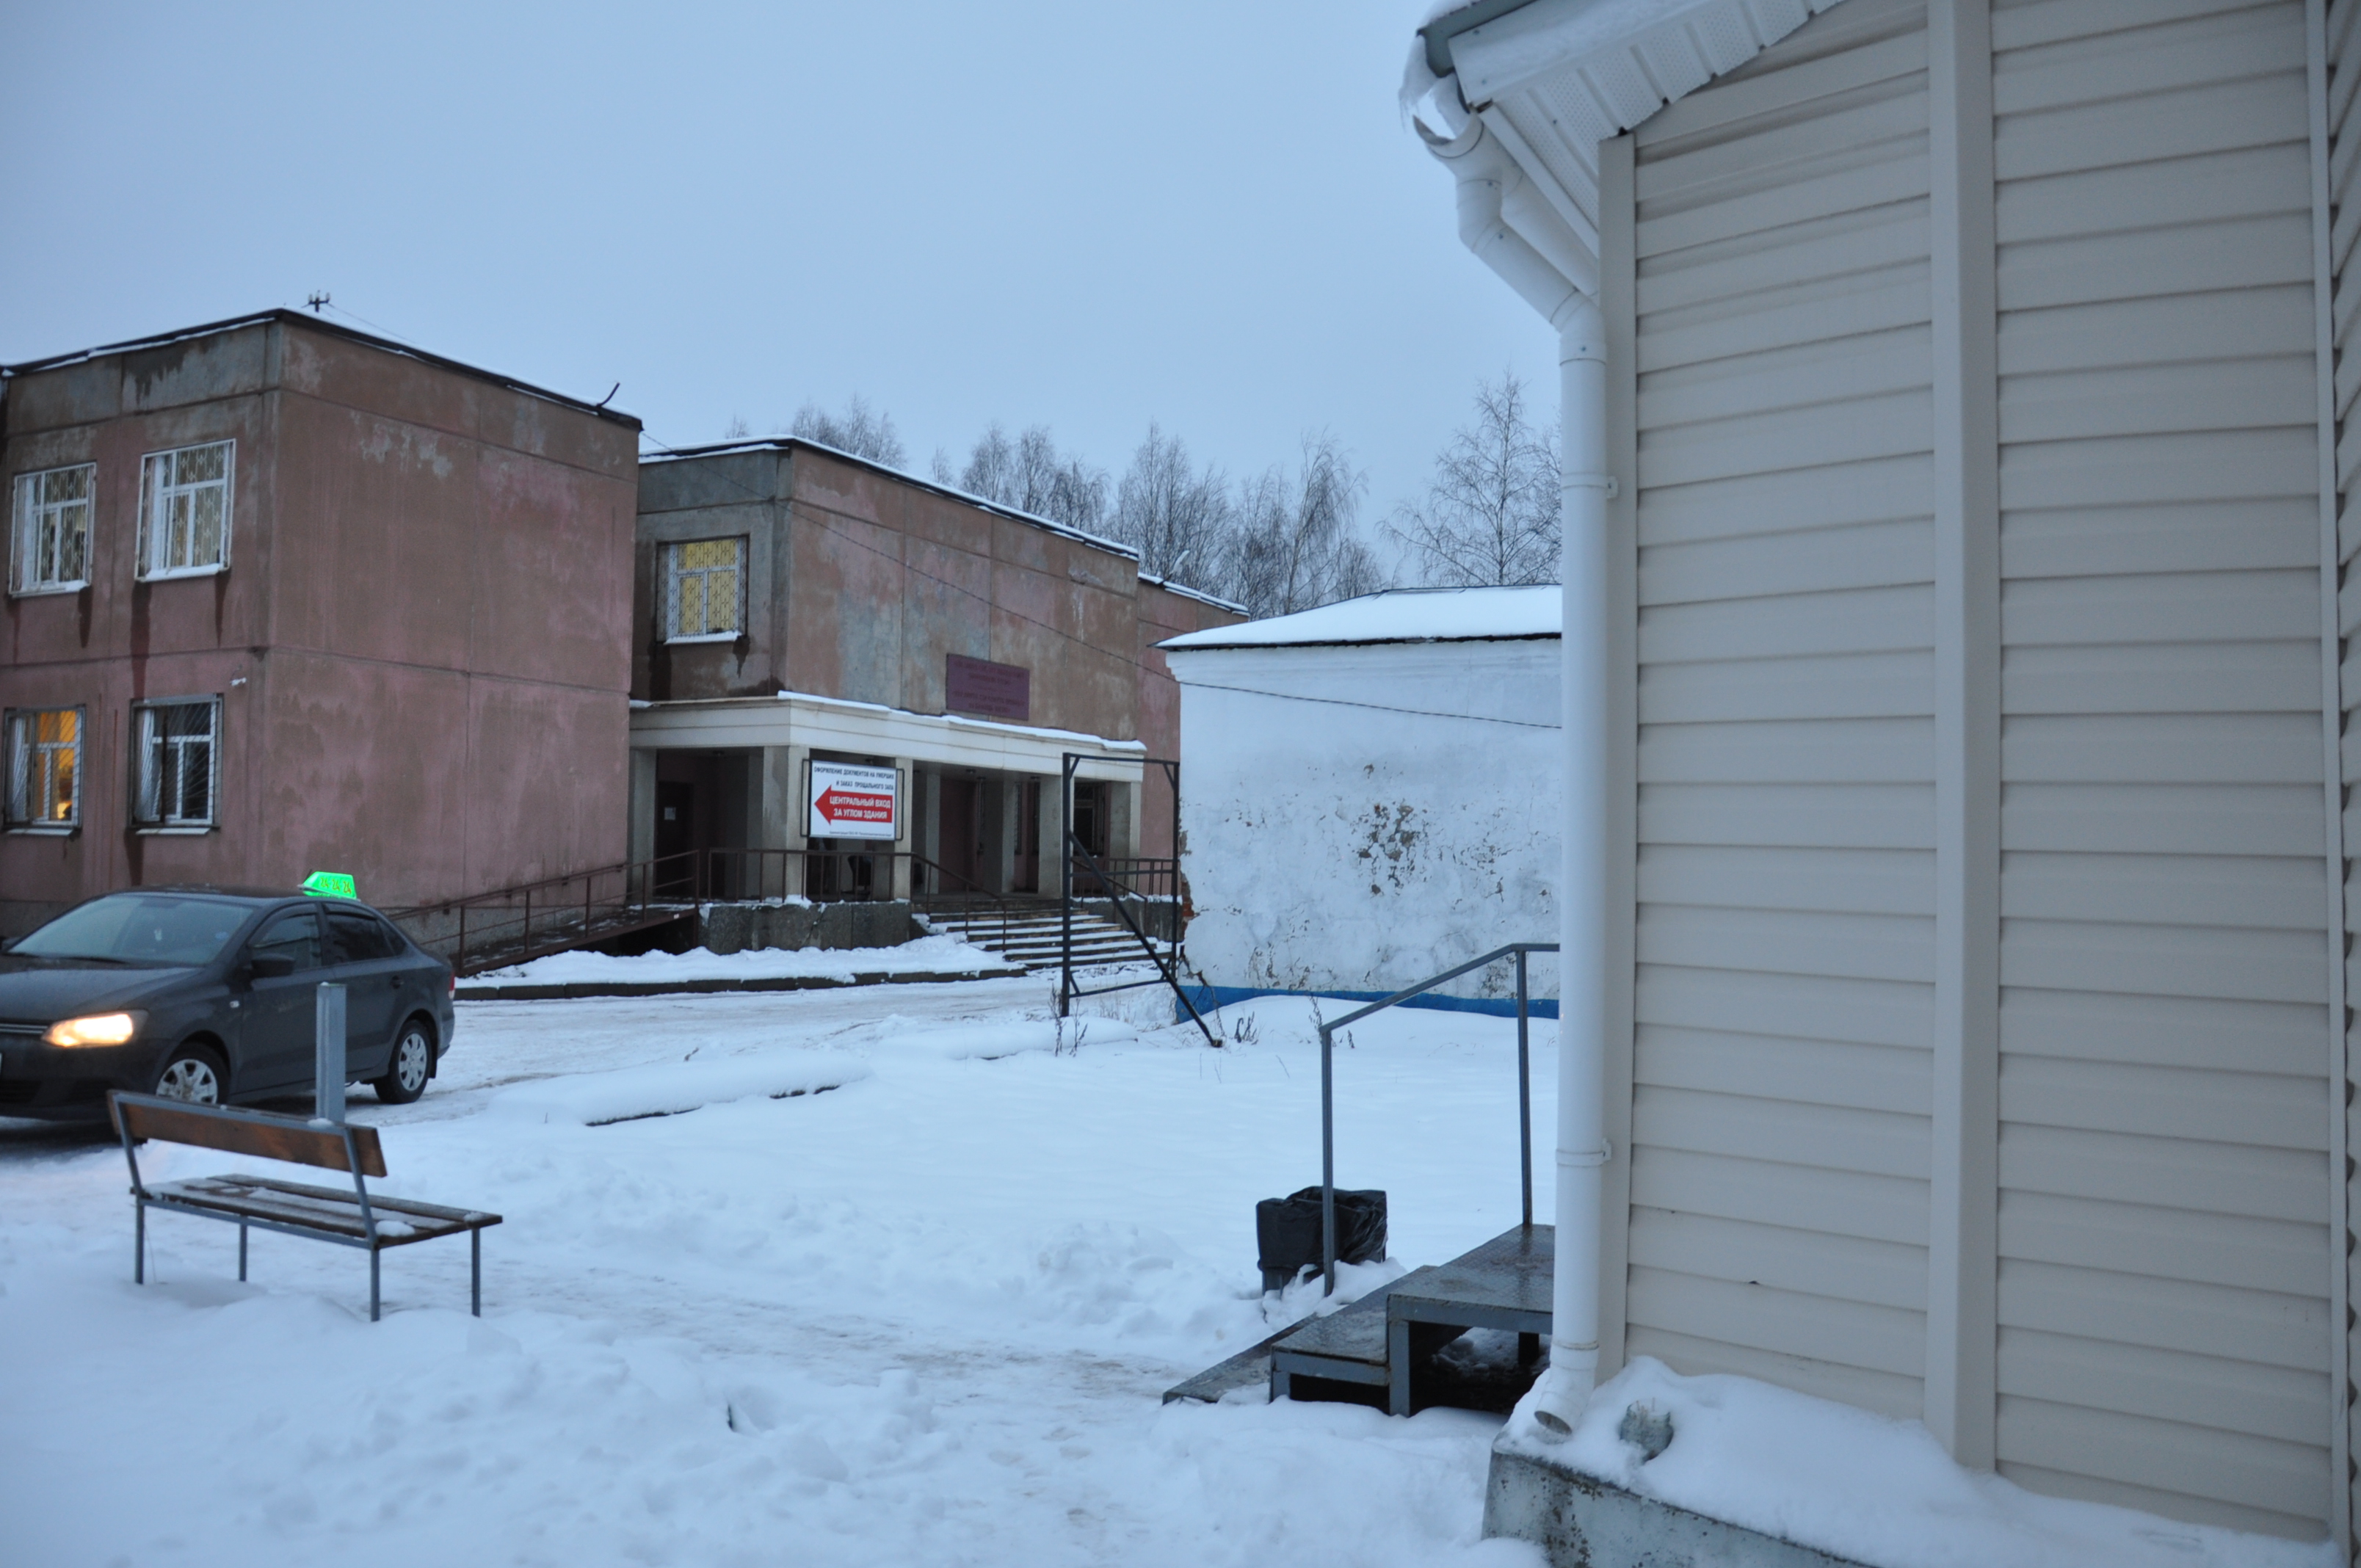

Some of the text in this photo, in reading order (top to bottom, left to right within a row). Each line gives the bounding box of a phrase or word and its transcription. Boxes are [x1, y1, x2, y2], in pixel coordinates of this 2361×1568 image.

[814, 766, 842, 774] ОФОРМЛЕНИЕ
[830, 796, 891, 808] ЦЕНТРАЛЬНЫЙ ВХОД
[834, 808, 887, 819] ЗА УГЛОМ ЗДАНИЯ
